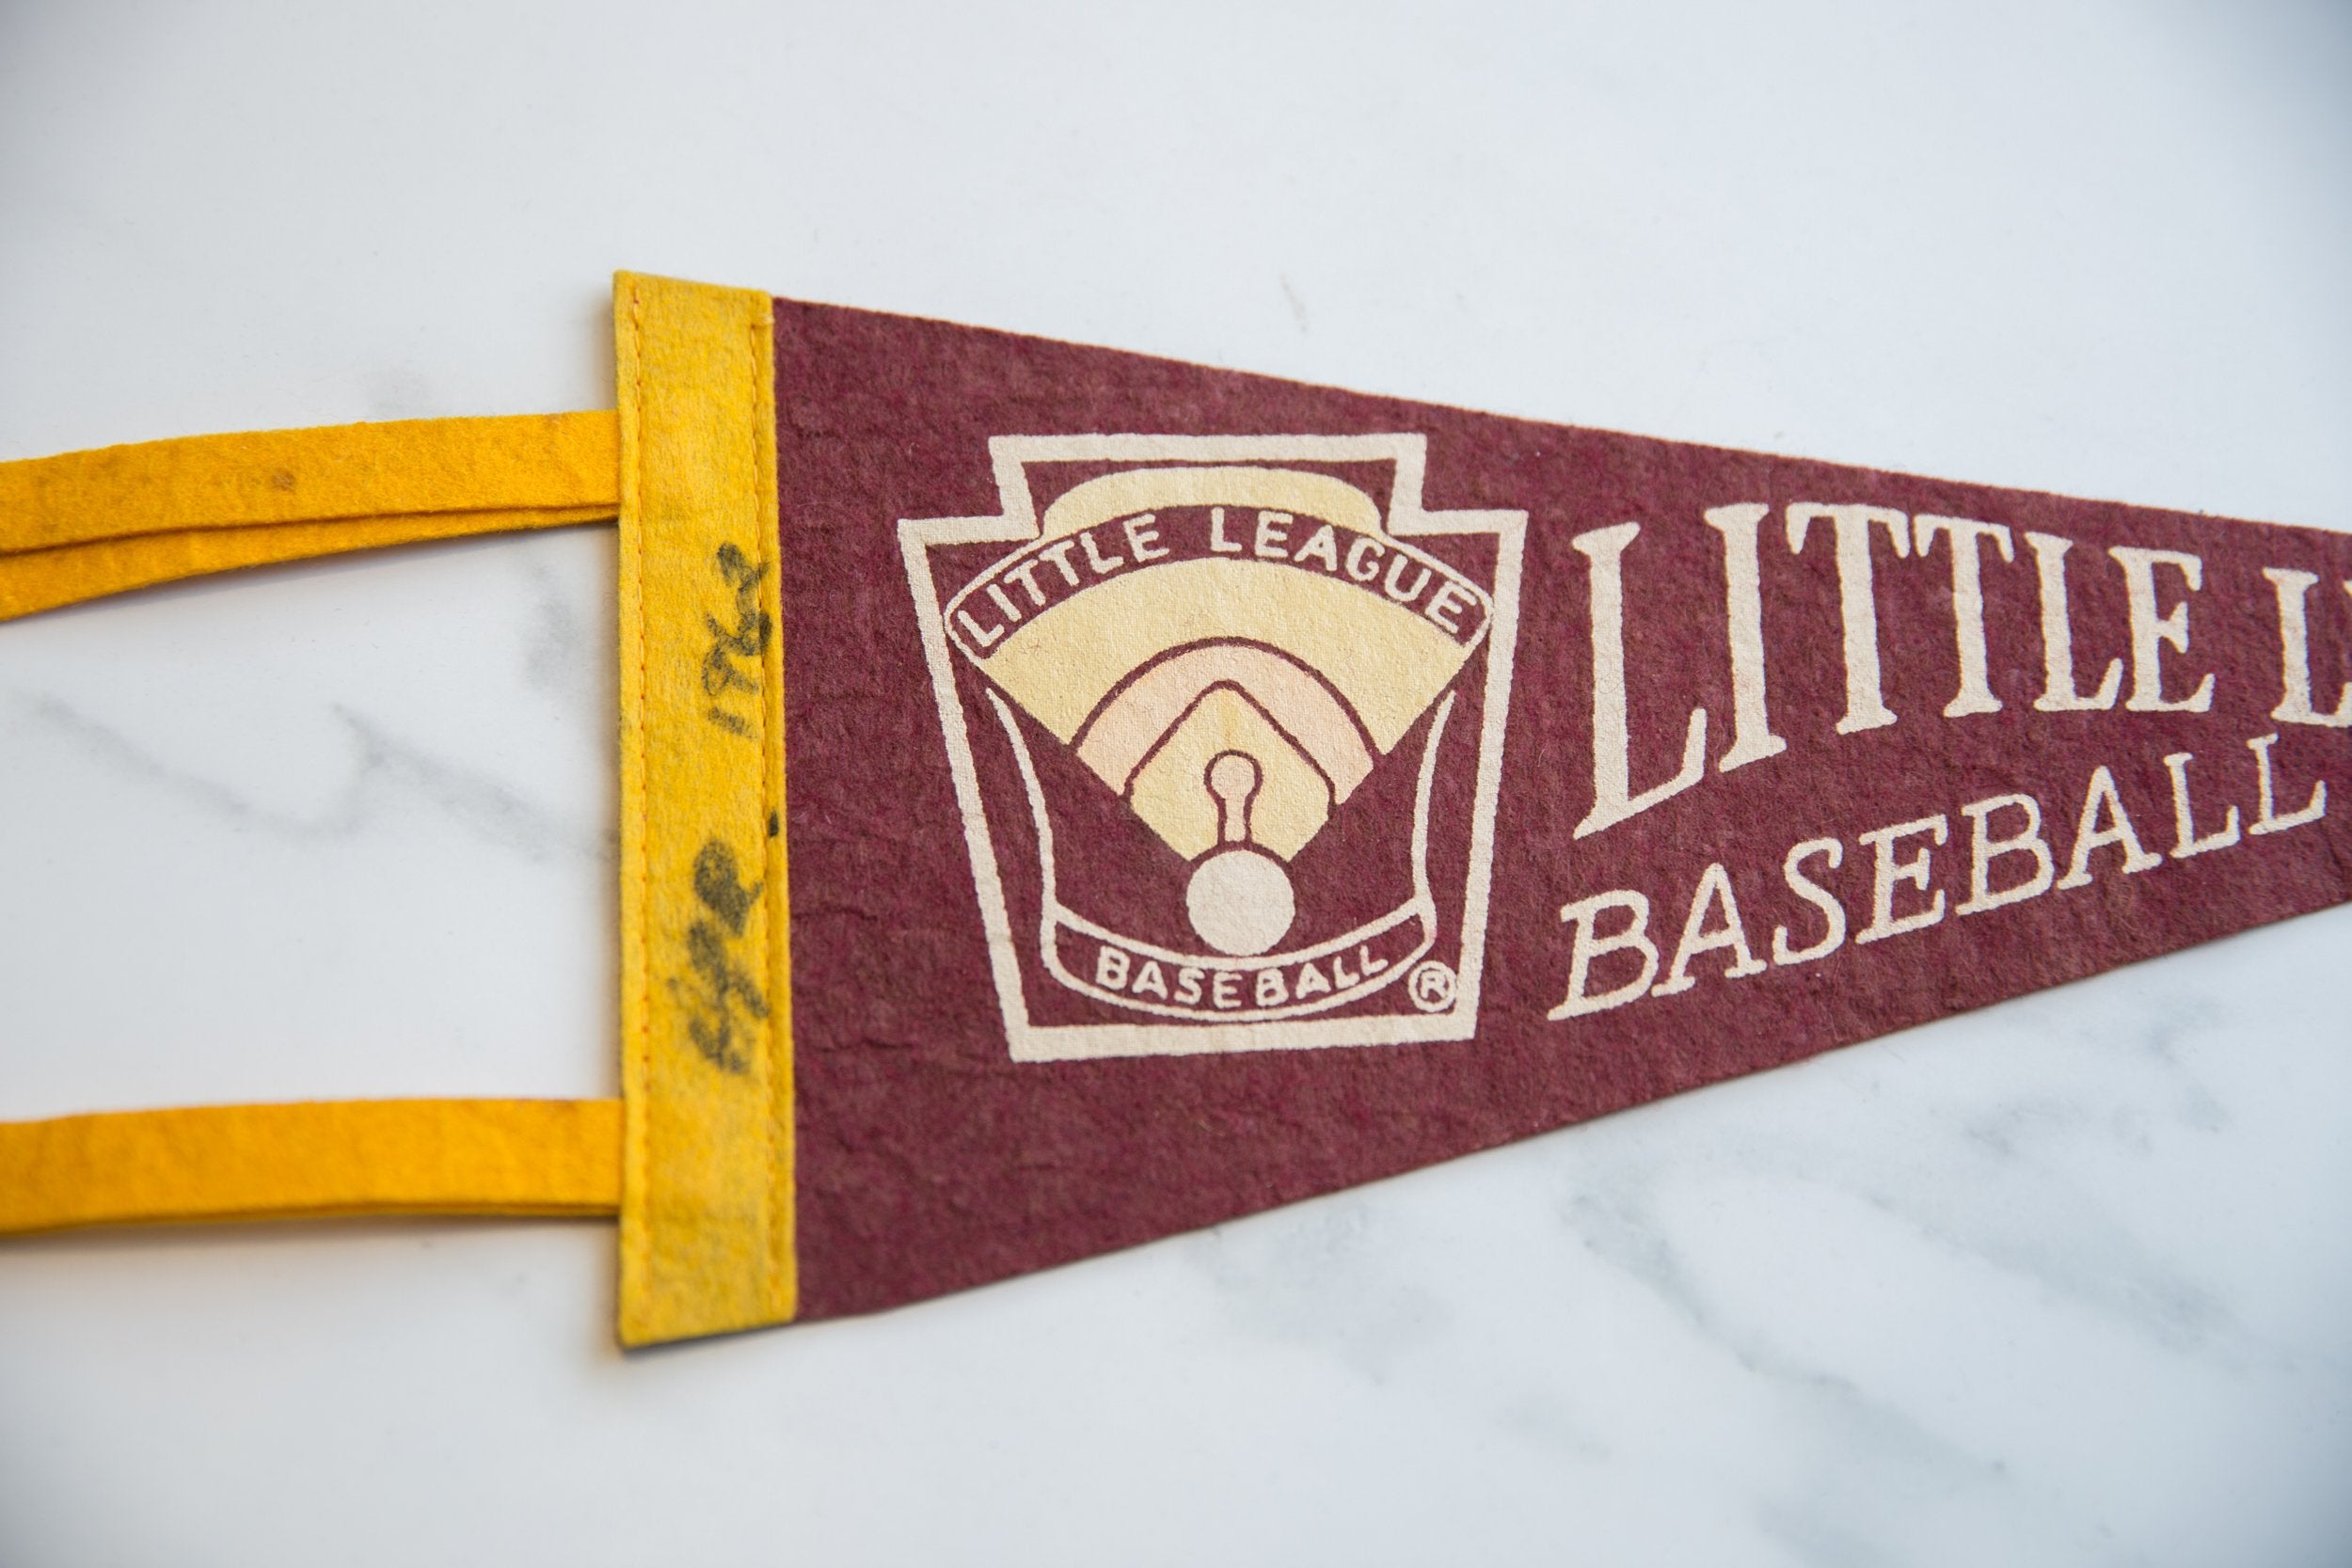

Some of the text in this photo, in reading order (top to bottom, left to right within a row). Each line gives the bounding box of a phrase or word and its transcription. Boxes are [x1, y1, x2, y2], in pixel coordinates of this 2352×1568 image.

[958, 506, 1476, 646] LITTLE LEAGUE
[1572, 501, 2352, 839] LITTLE L
[1095, 943, 1389, 1007] BASEBALL
[1547, 734, 2327, 1021] BASEBALL
